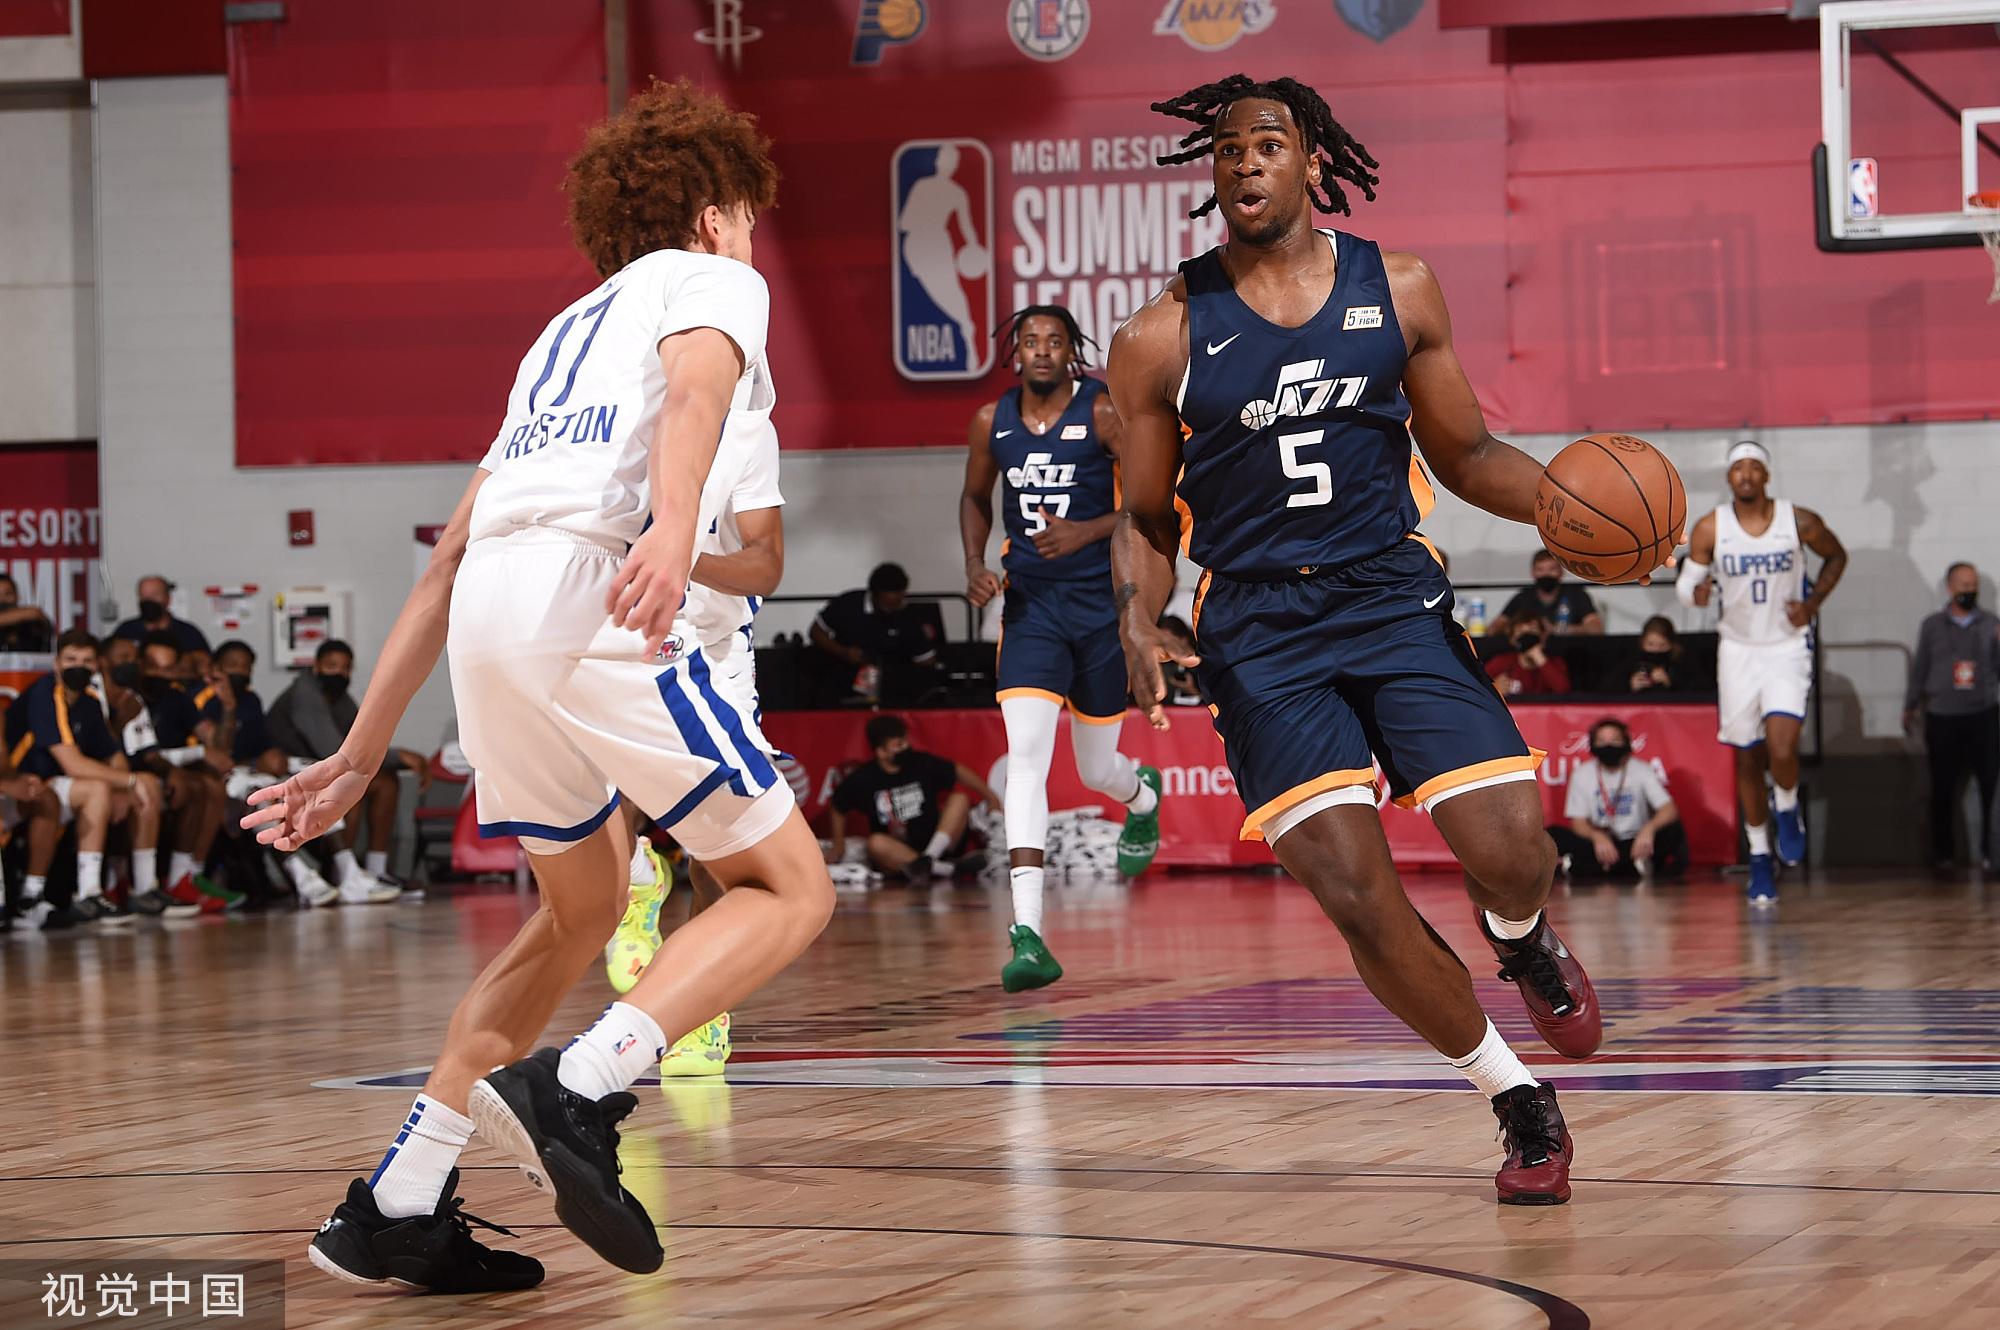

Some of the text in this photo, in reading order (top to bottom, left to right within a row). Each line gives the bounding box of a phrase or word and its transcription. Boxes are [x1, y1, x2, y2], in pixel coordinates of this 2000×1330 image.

[1011, 133, 1212, 175] MGM RESO
[1013, 181, 1230, 279] SUMMER
[1347, 310, 1357, 327] 5
[1359, 317, 1379, 326] FIGHT
[528, 285, 625, 417] 17
[908, 324, 956, 362] NBA
[503, 404, 618, 460] RESTON
[1278, 429, 1333, 508] 5
[1019, 493, 1071, 537] 57
[1722, 549, 1795, 578] CLIPPERS
[1752, 579, 1767, 604] 0
[1161, 765, 1238, 797] nne
